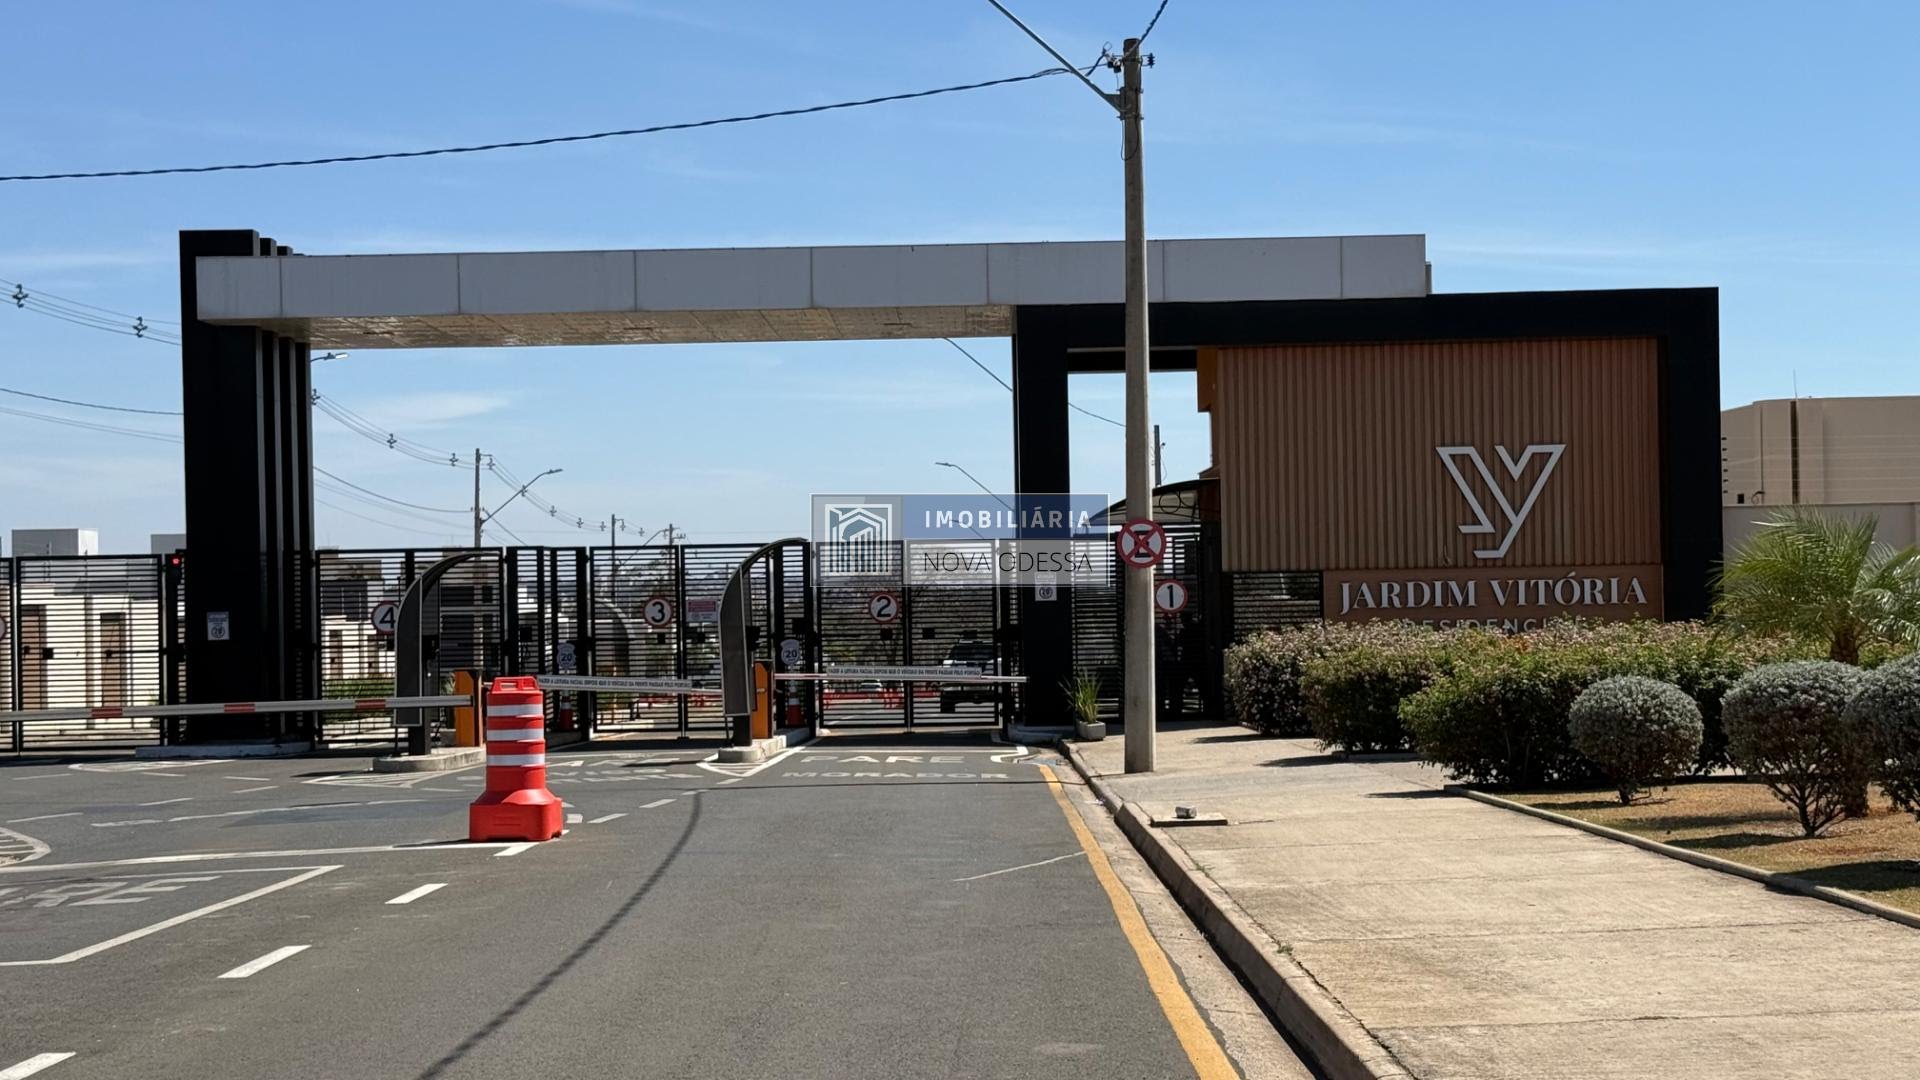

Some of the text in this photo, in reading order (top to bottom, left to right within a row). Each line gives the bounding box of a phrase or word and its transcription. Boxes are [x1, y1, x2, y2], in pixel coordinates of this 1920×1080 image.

[1166, 584, 1174, 608] 1
[1340, 571, 1648, 616] JARDIM VITÓRIA
[378, 606, 396, 629] 4
[651, 601, 666, 623] 3
[876, 595, 892, 618] 2
[561, 653, 573, 662] 20
[785, 649, 798, 658] 20
[801, 755, 966, 763] PARE
